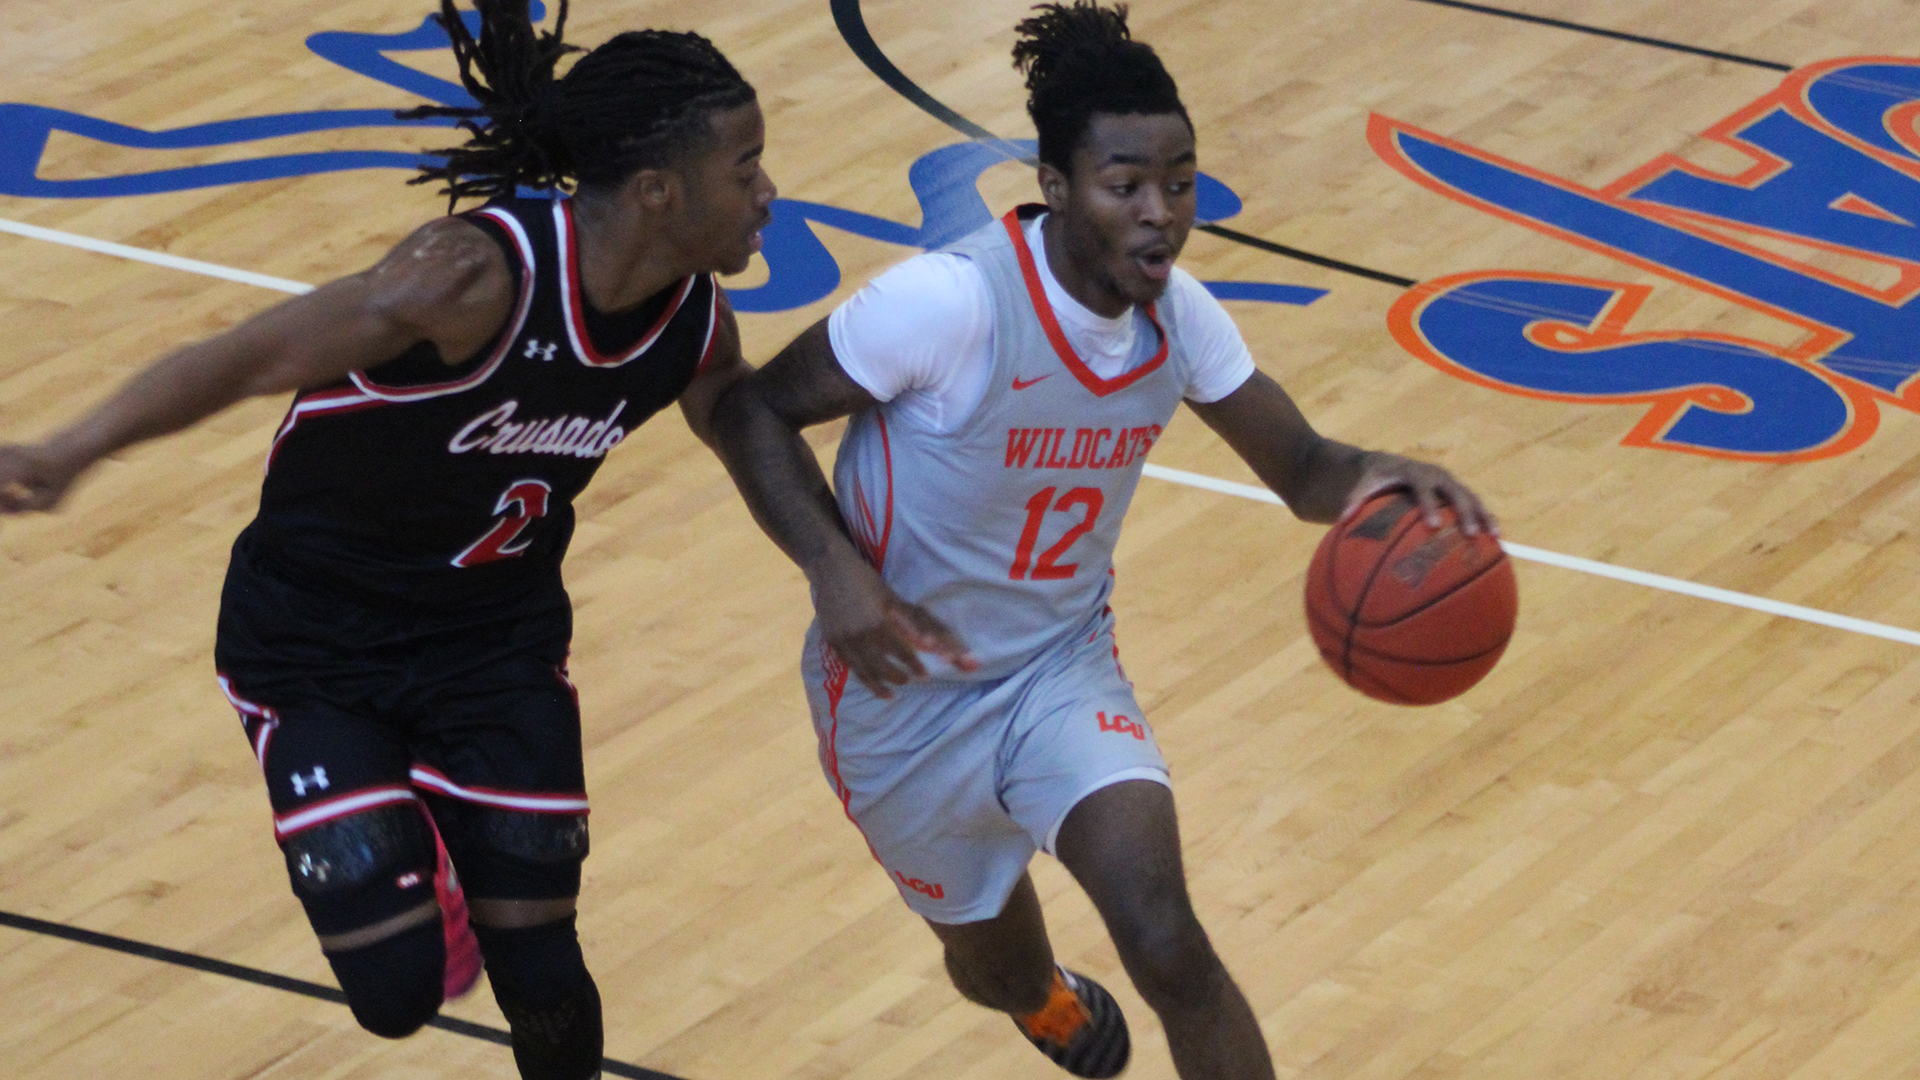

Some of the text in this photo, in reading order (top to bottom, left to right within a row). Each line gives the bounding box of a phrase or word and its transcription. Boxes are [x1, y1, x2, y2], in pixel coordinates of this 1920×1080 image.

[1004, 423, 1163, 469] WILDCATS
[450, 479, 551, 568] 2
[1008, 486, 1104, 580] 12
[1096, 711, 1146, 741] LCU
[895, 870, 945, 900] LCU
